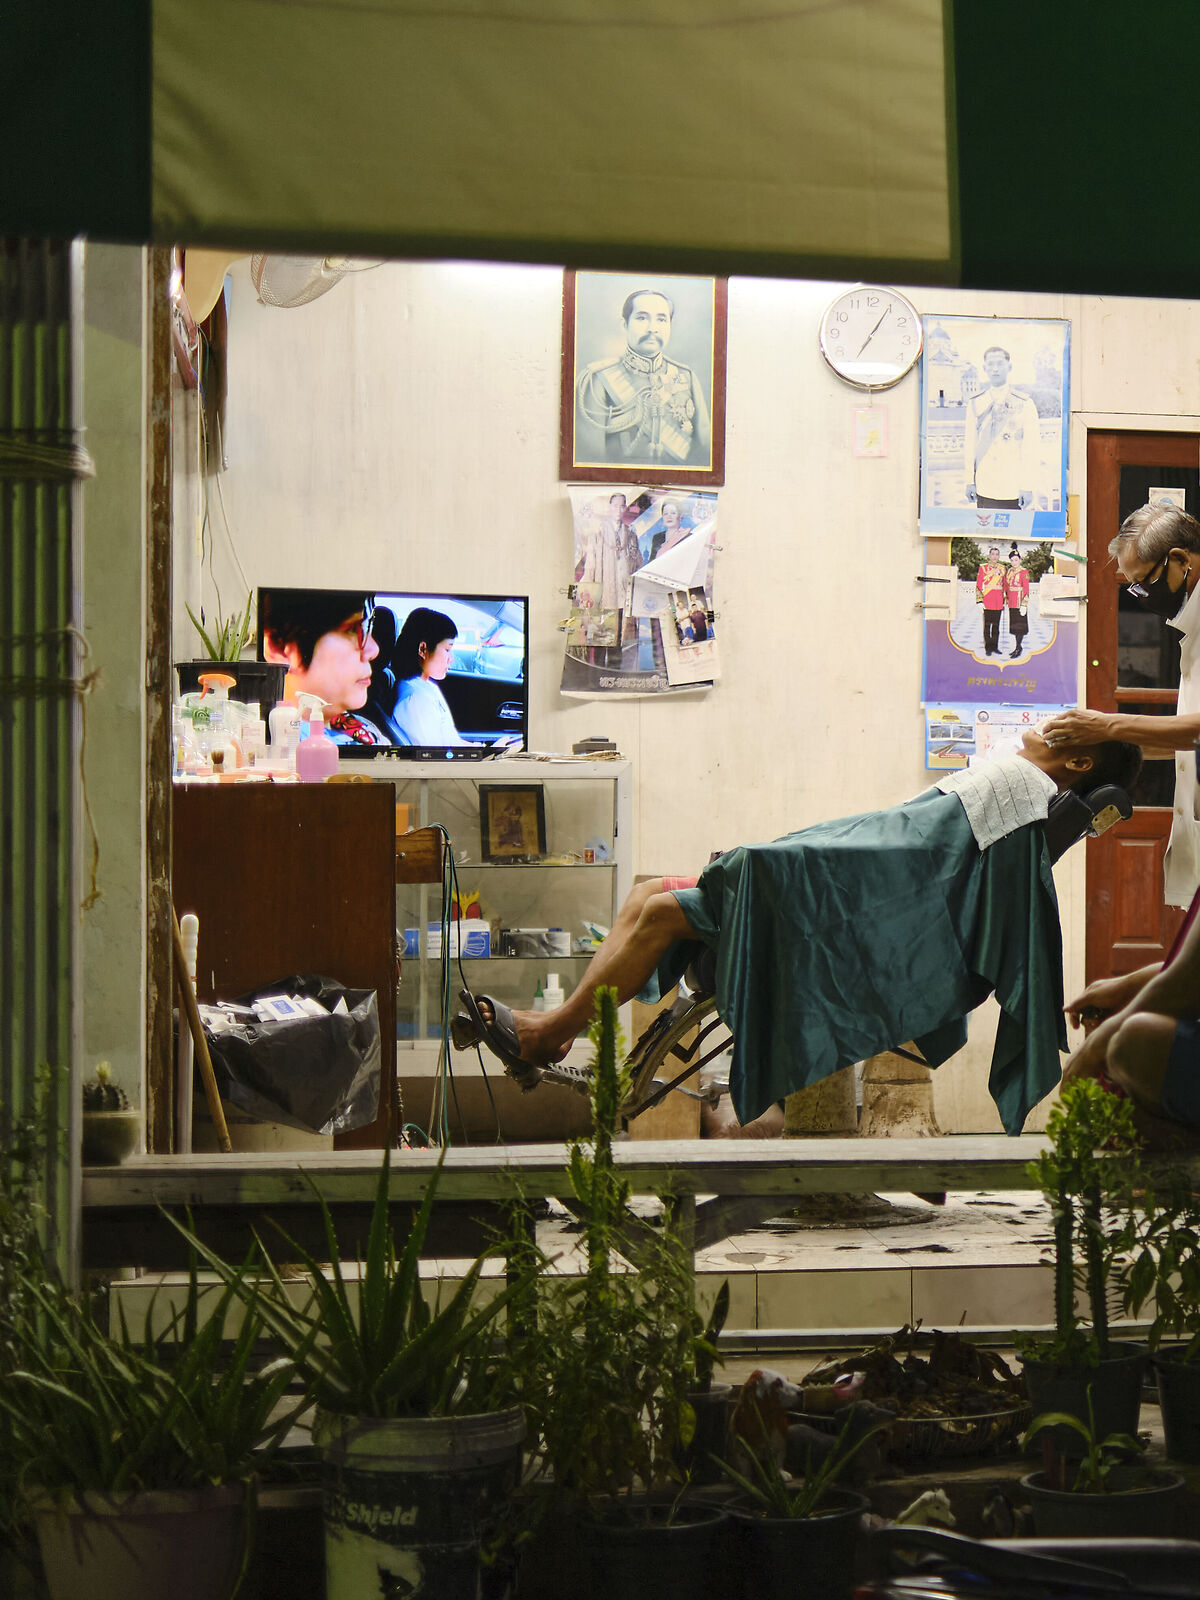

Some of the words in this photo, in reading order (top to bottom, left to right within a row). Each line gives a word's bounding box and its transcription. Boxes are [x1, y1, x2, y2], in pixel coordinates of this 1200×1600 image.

[850, 299, 860, 310] 11
[867, 296, 880, 308] 12
[836, 311, 849, 323] 10
[896, 317, 907, 328] 2
[830, 328, 840, 339] 9
[902, 335, 911, 346] 3
[1021, 711, 1031, 724] 8
[345, 1502, 419, 1526] Shield
